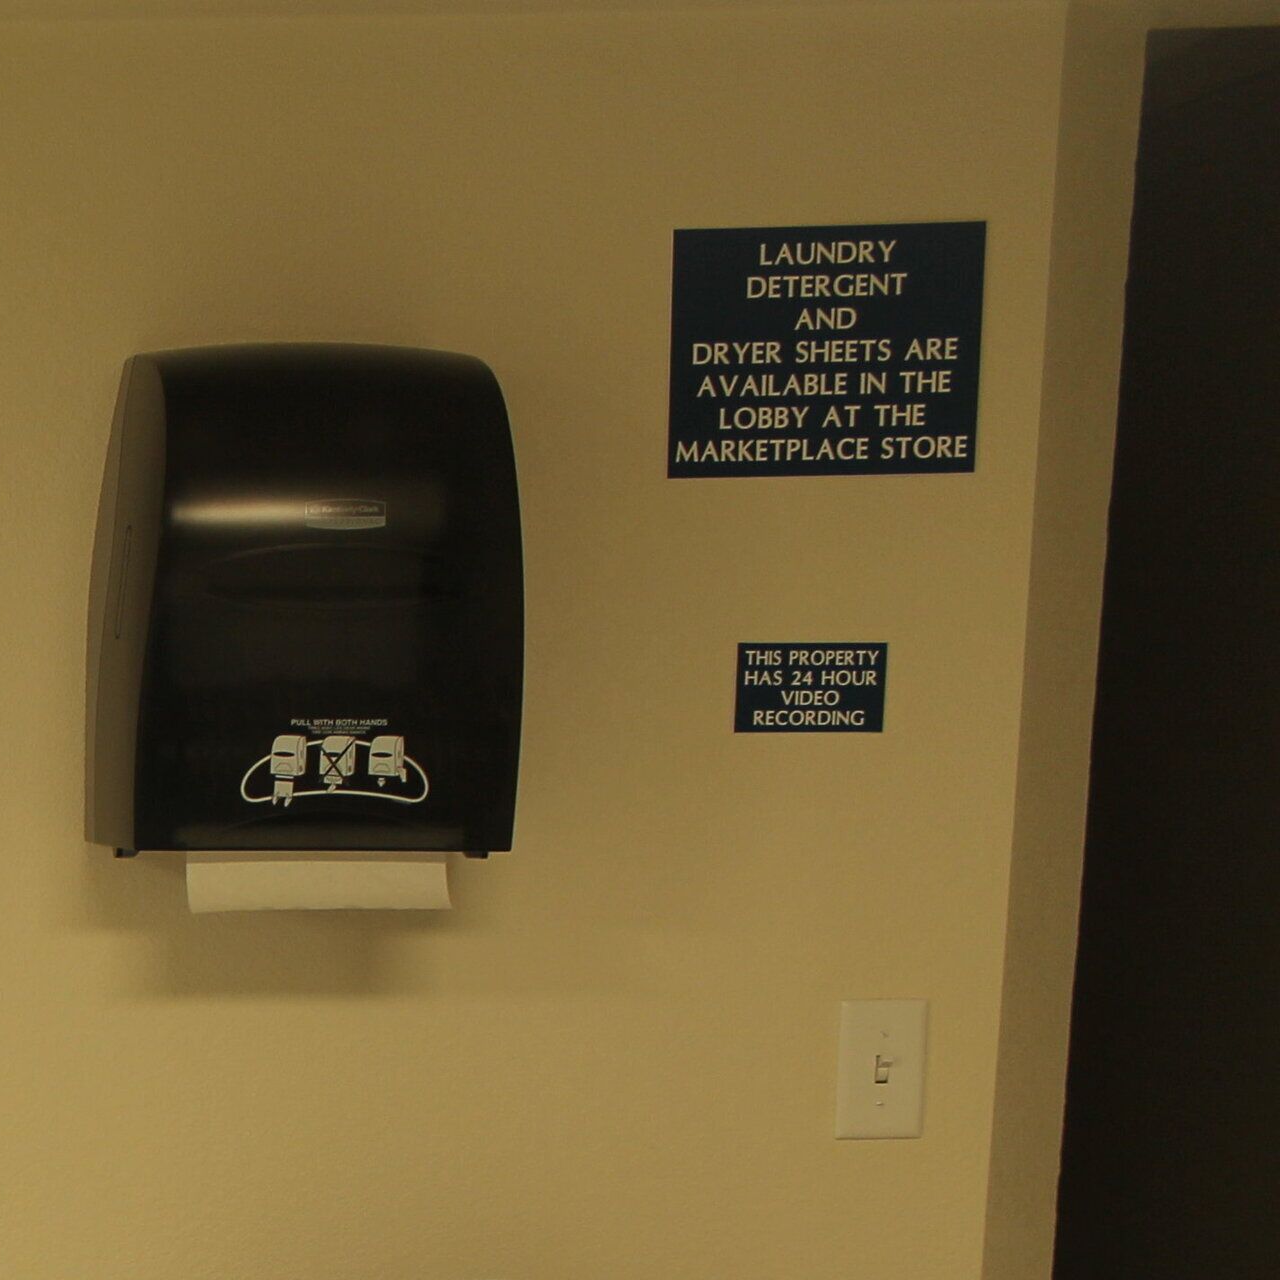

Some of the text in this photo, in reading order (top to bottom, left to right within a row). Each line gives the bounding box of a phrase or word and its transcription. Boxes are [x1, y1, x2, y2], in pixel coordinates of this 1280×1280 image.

[759, 239, 897, 266] LAUNDRY
[746, 272, 908, 299] DETERGENT
[794, 307, 857, 331] AND
[692, 337, 959, 365] DRYER SHEETS ARE
[696, 370, 952, 398] AVAILABLE IN THE
[719, 403, 926, 430] LOBBY AT THE
[675, 435, 968, 463] MARKETPLACE STORE
[745, 649, 880, 666] THIS PROPERTY
[744, 669, 877, 686] HAS 24 HOUR
[780, 689, 840, 706] VIDEO
[290, 718, 311, 726] PULL
[313, 718, 334, 726] WITH
[359, 718, 388, 726] HANDS
[752, 709, 865, 726] RECORDING
